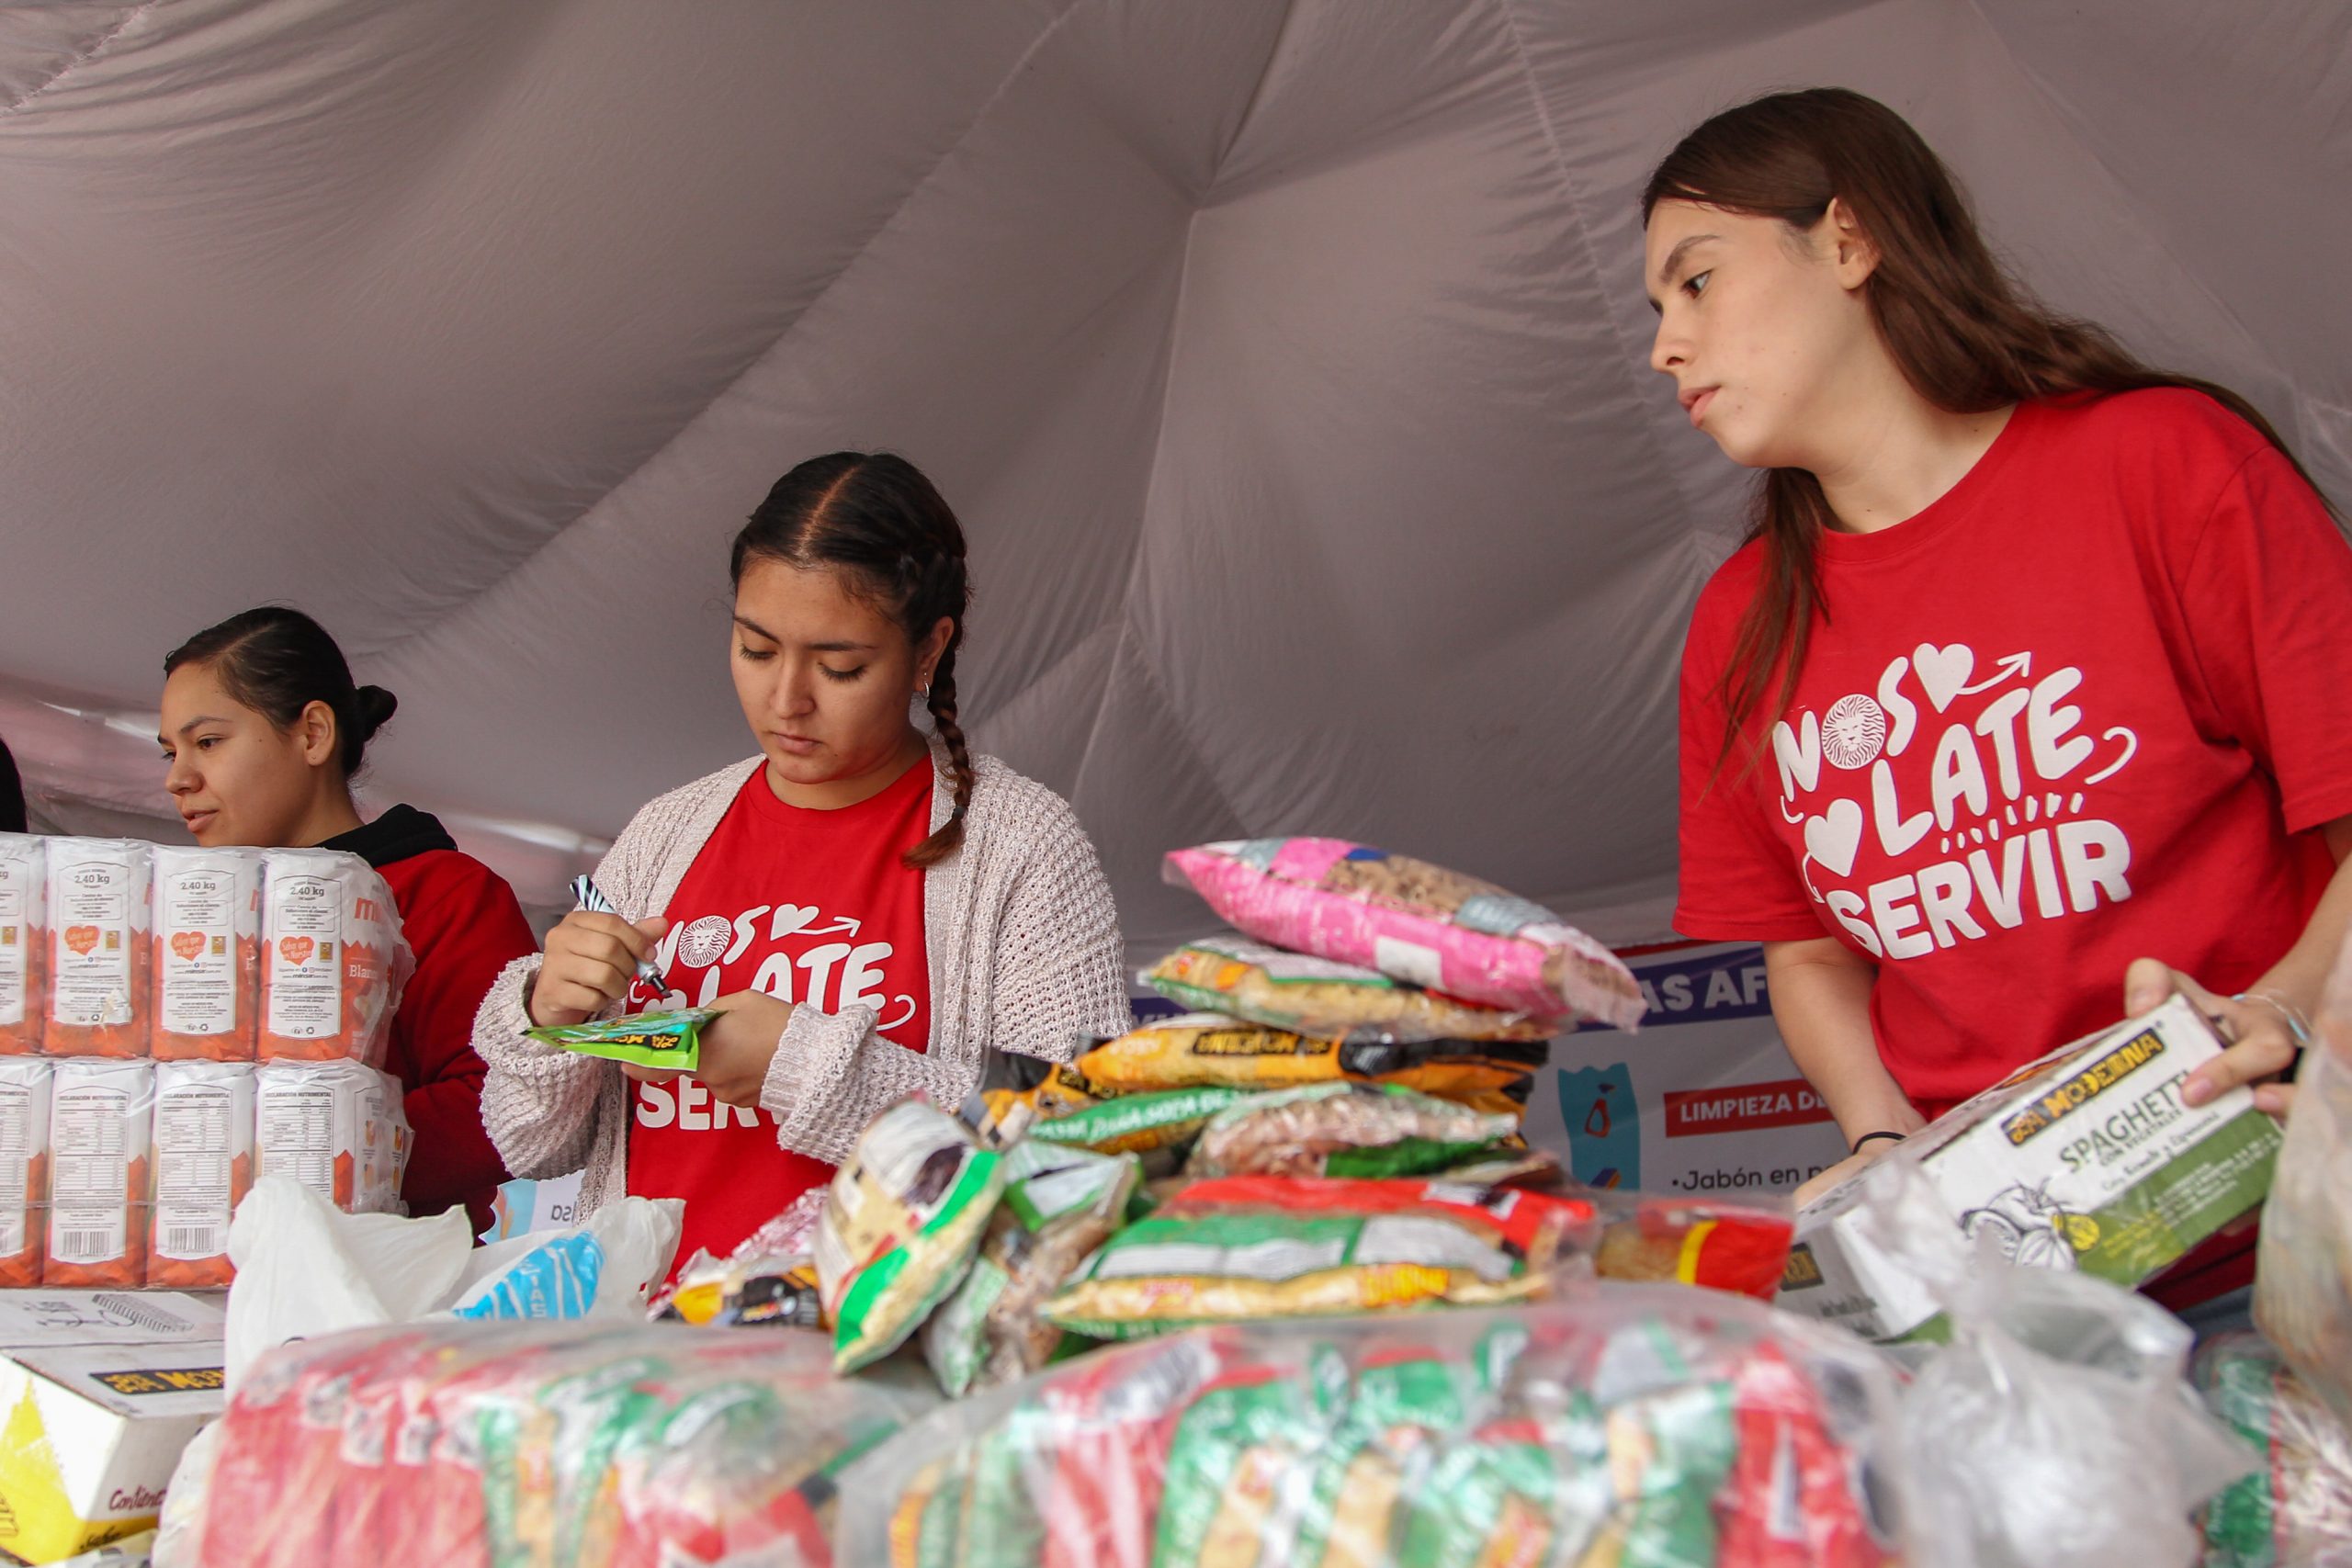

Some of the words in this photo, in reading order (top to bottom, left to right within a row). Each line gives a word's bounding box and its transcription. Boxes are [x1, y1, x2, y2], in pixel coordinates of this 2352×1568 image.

[1772, 657, 1917, 803] NOS
[1871, 667, 2094, 856] LATE
[74, 874, 95, 884] 2.40
[97, 874, 110, 886] kg
[181, 882, 201, 890] 2.40
[203, 881, 216, 891] kg
[290, 886, 310, 896] 2.40
[312, 886, 324, 897] kg
[1826, 819, 2132, 960] SERVIR
[636, 1074, 781, 1131] SER
[1680, 1093, 1793, 1122] LIMPIEZA
[2060, 1070, 2190, 1174] SPAGHETT
[1683, 1167, 1762, 1190] Jabón
[1770, 1169, 1800, 1184] en
